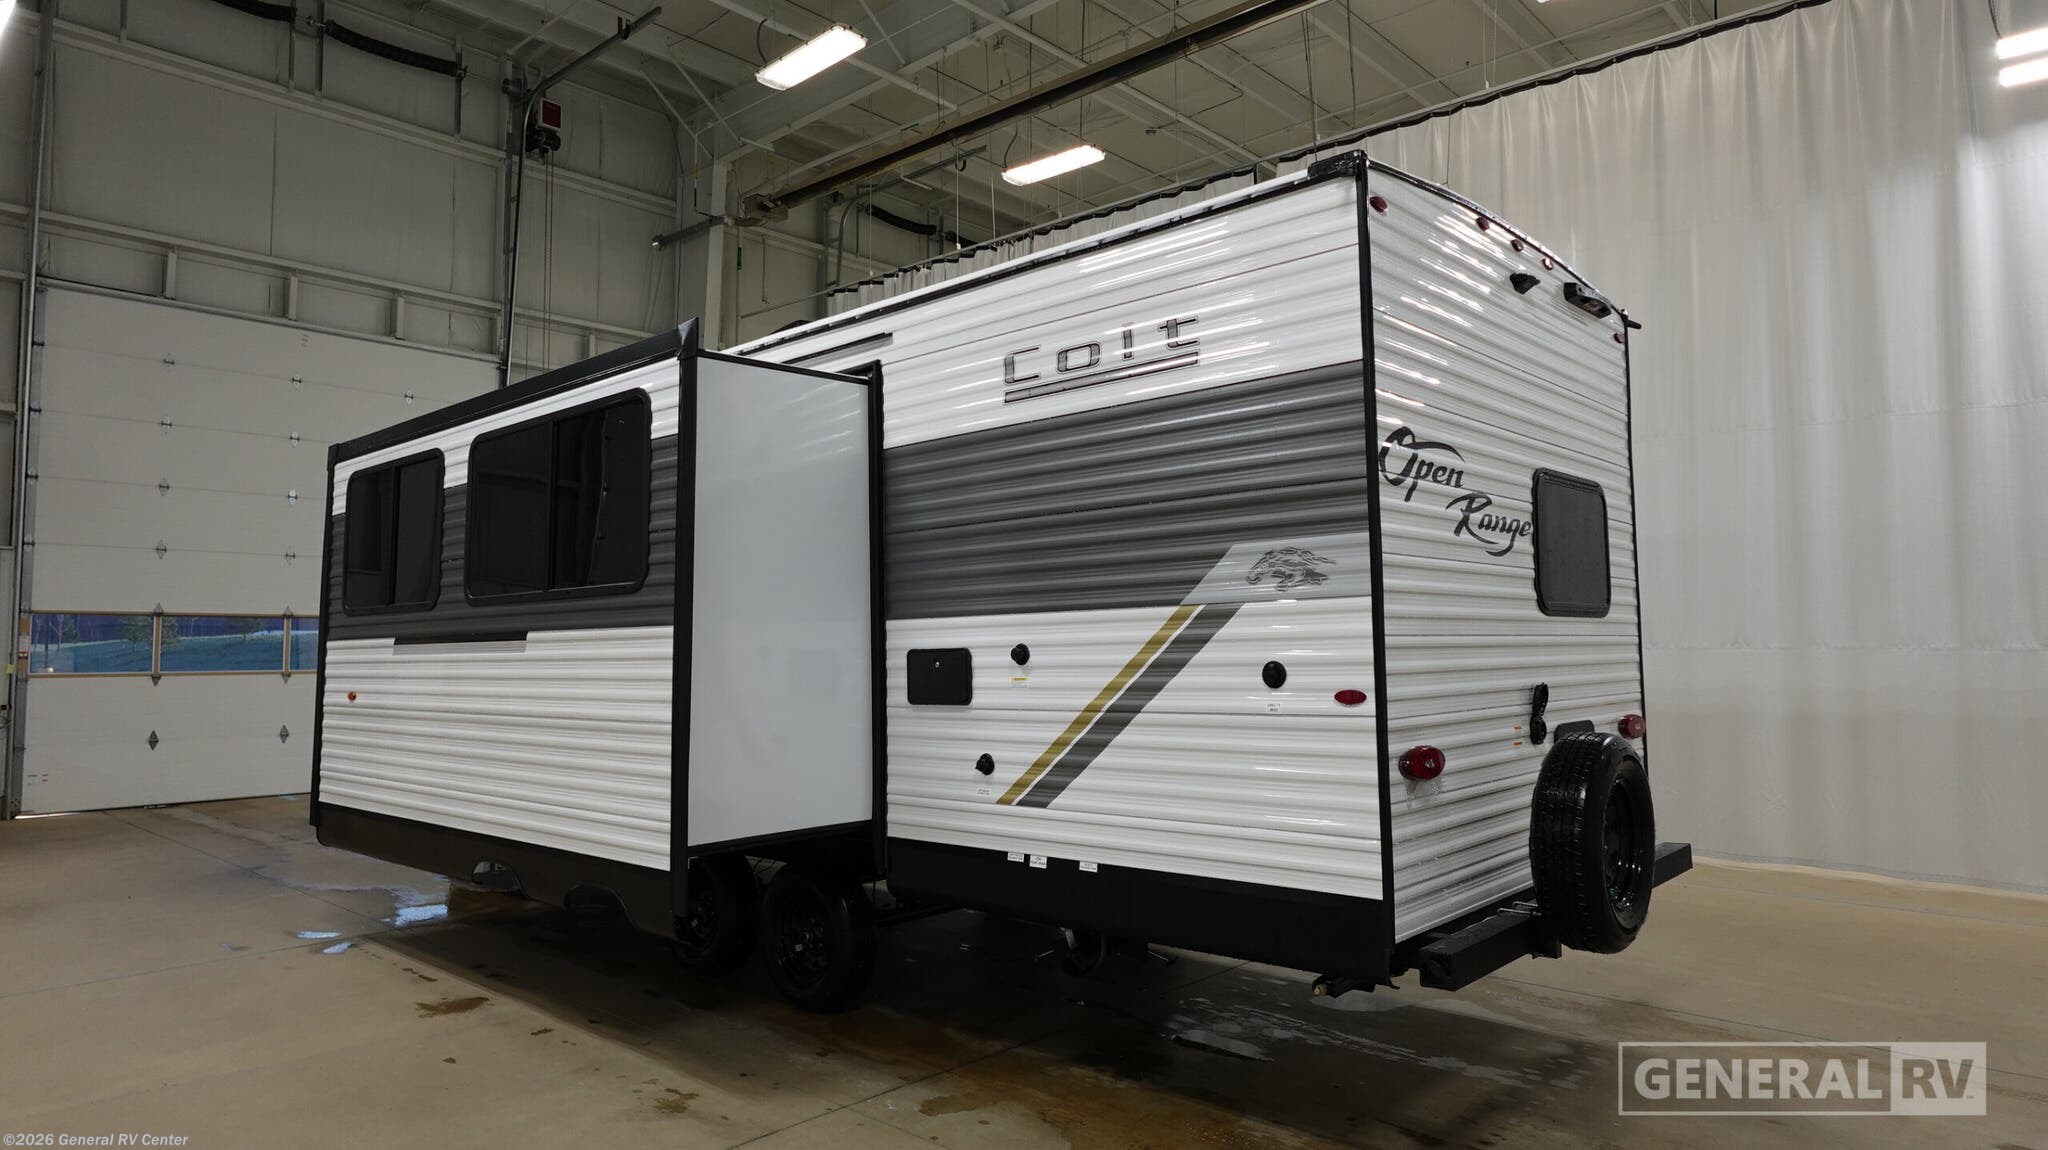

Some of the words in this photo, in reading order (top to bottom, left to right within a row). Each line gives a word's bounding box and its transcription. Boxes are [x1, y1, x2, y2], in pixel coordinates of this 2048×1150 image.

[1003, 316, 1199, 385] Colt
[1378, 426, 1465, 503] Open
[1445, 492, 1531, 557] Range
